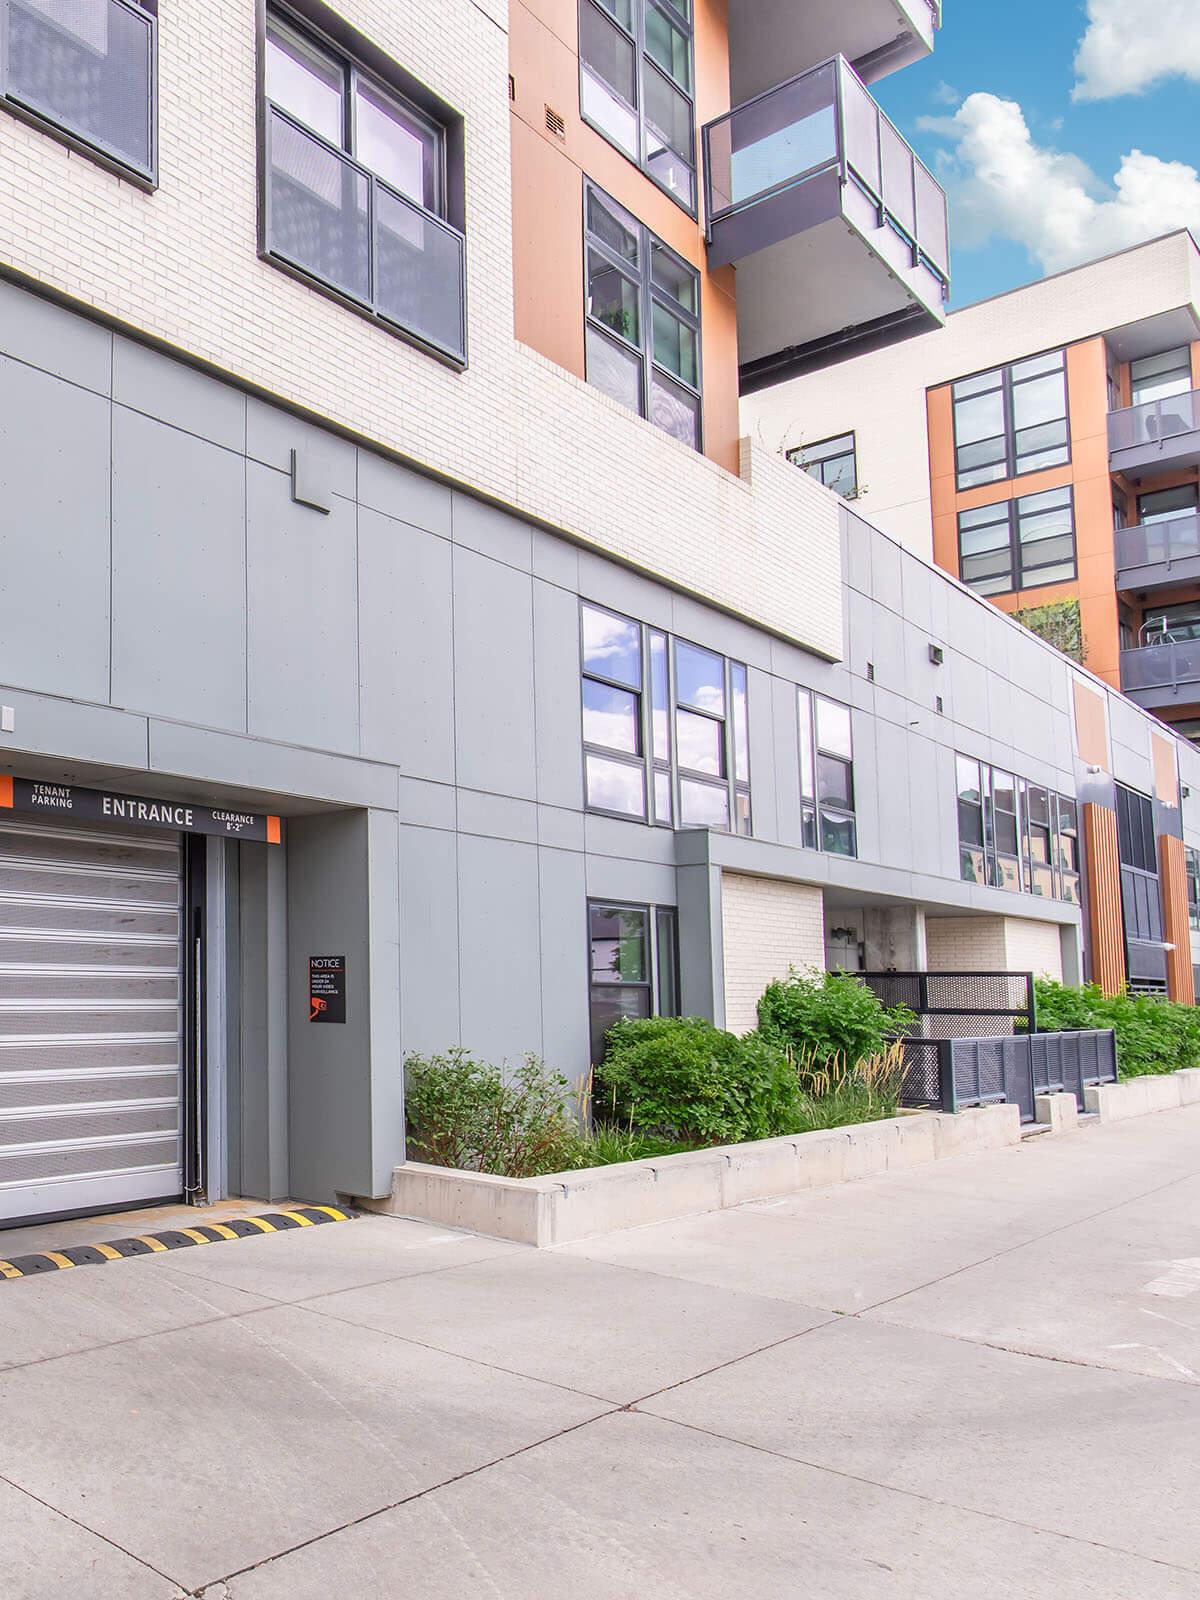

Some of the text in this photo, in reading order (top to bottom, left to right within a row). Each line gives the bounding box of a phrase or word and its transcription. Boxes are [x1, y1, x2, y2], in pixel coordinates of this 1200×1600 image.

[33, 784, 71, 798] TENANT
[31, 795, 73, 809] PARKING
[103, 797, 194, 826] ENTRANCE
[212, 811, 254, 824] CLEARANCE
[311, 959, 340, 968] NOTICE
